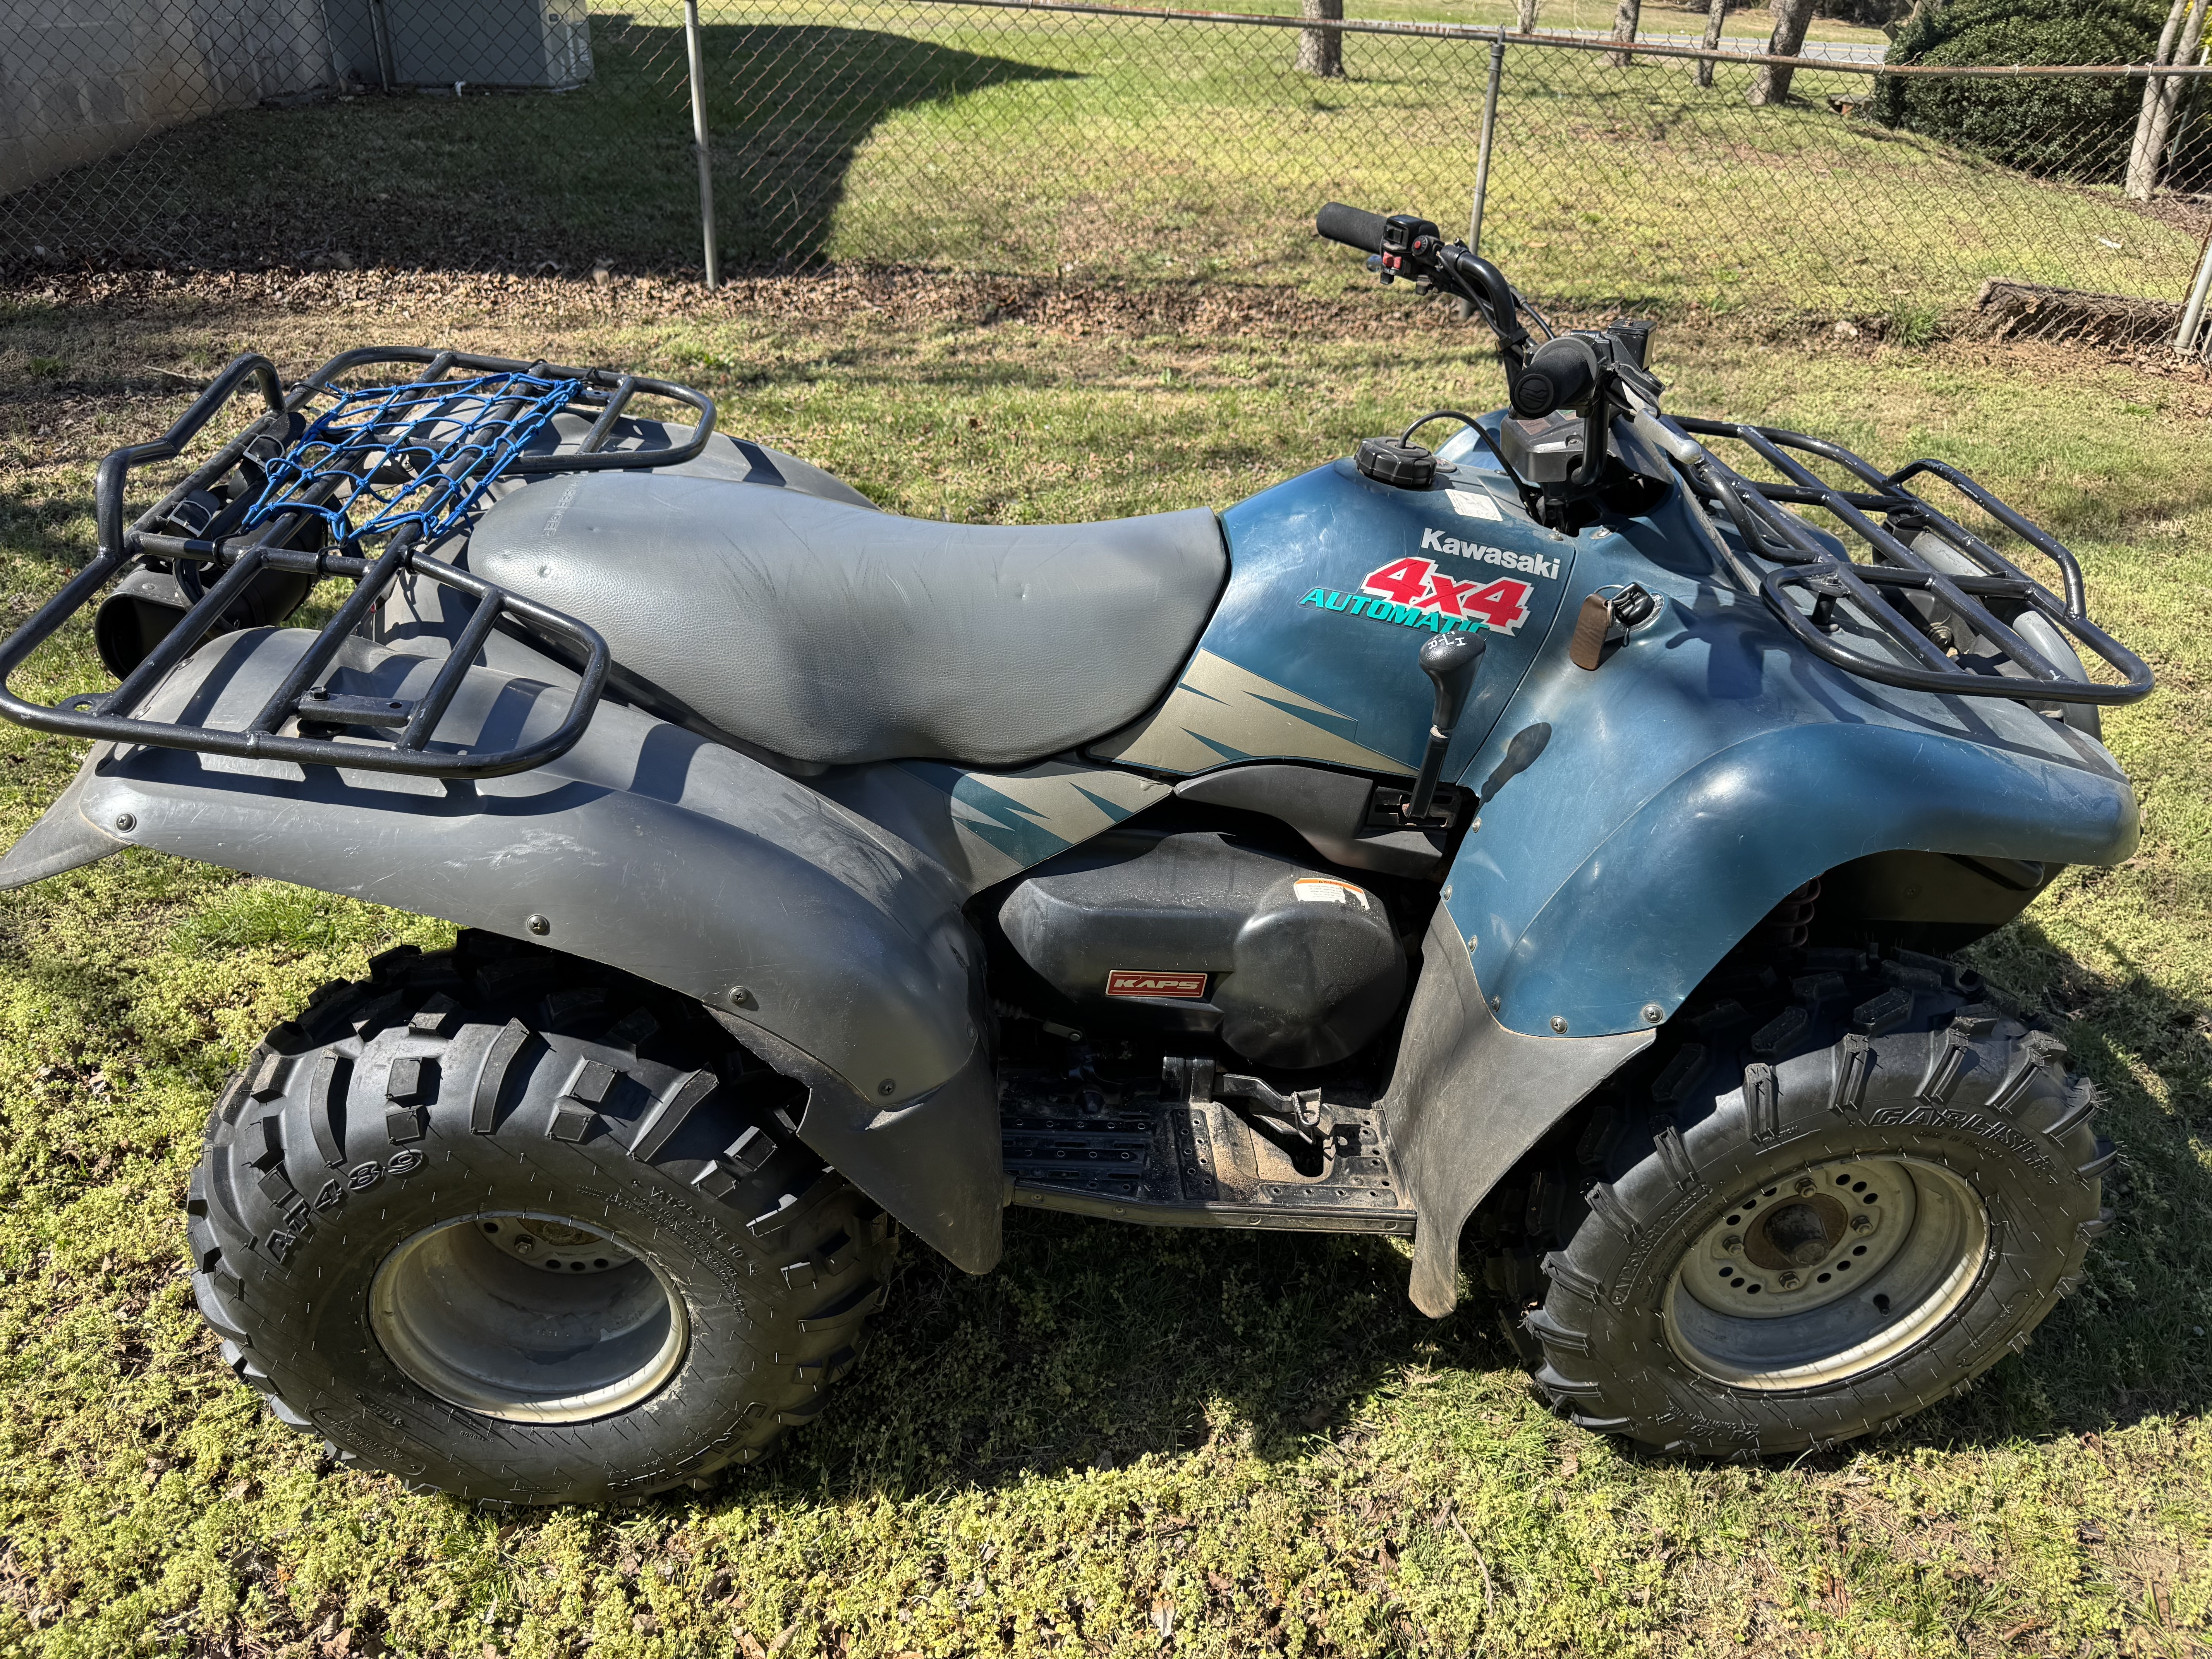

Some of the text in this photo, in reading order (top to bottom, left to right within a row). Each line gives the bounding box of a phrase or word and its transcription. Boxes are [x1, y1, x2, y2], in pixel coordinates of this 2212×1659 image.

[1421, 528, 1560, 580] Kawasaki
[1114, 979, 1200, 989] KAPS
[265, 1149, 426, 1264] AT489
